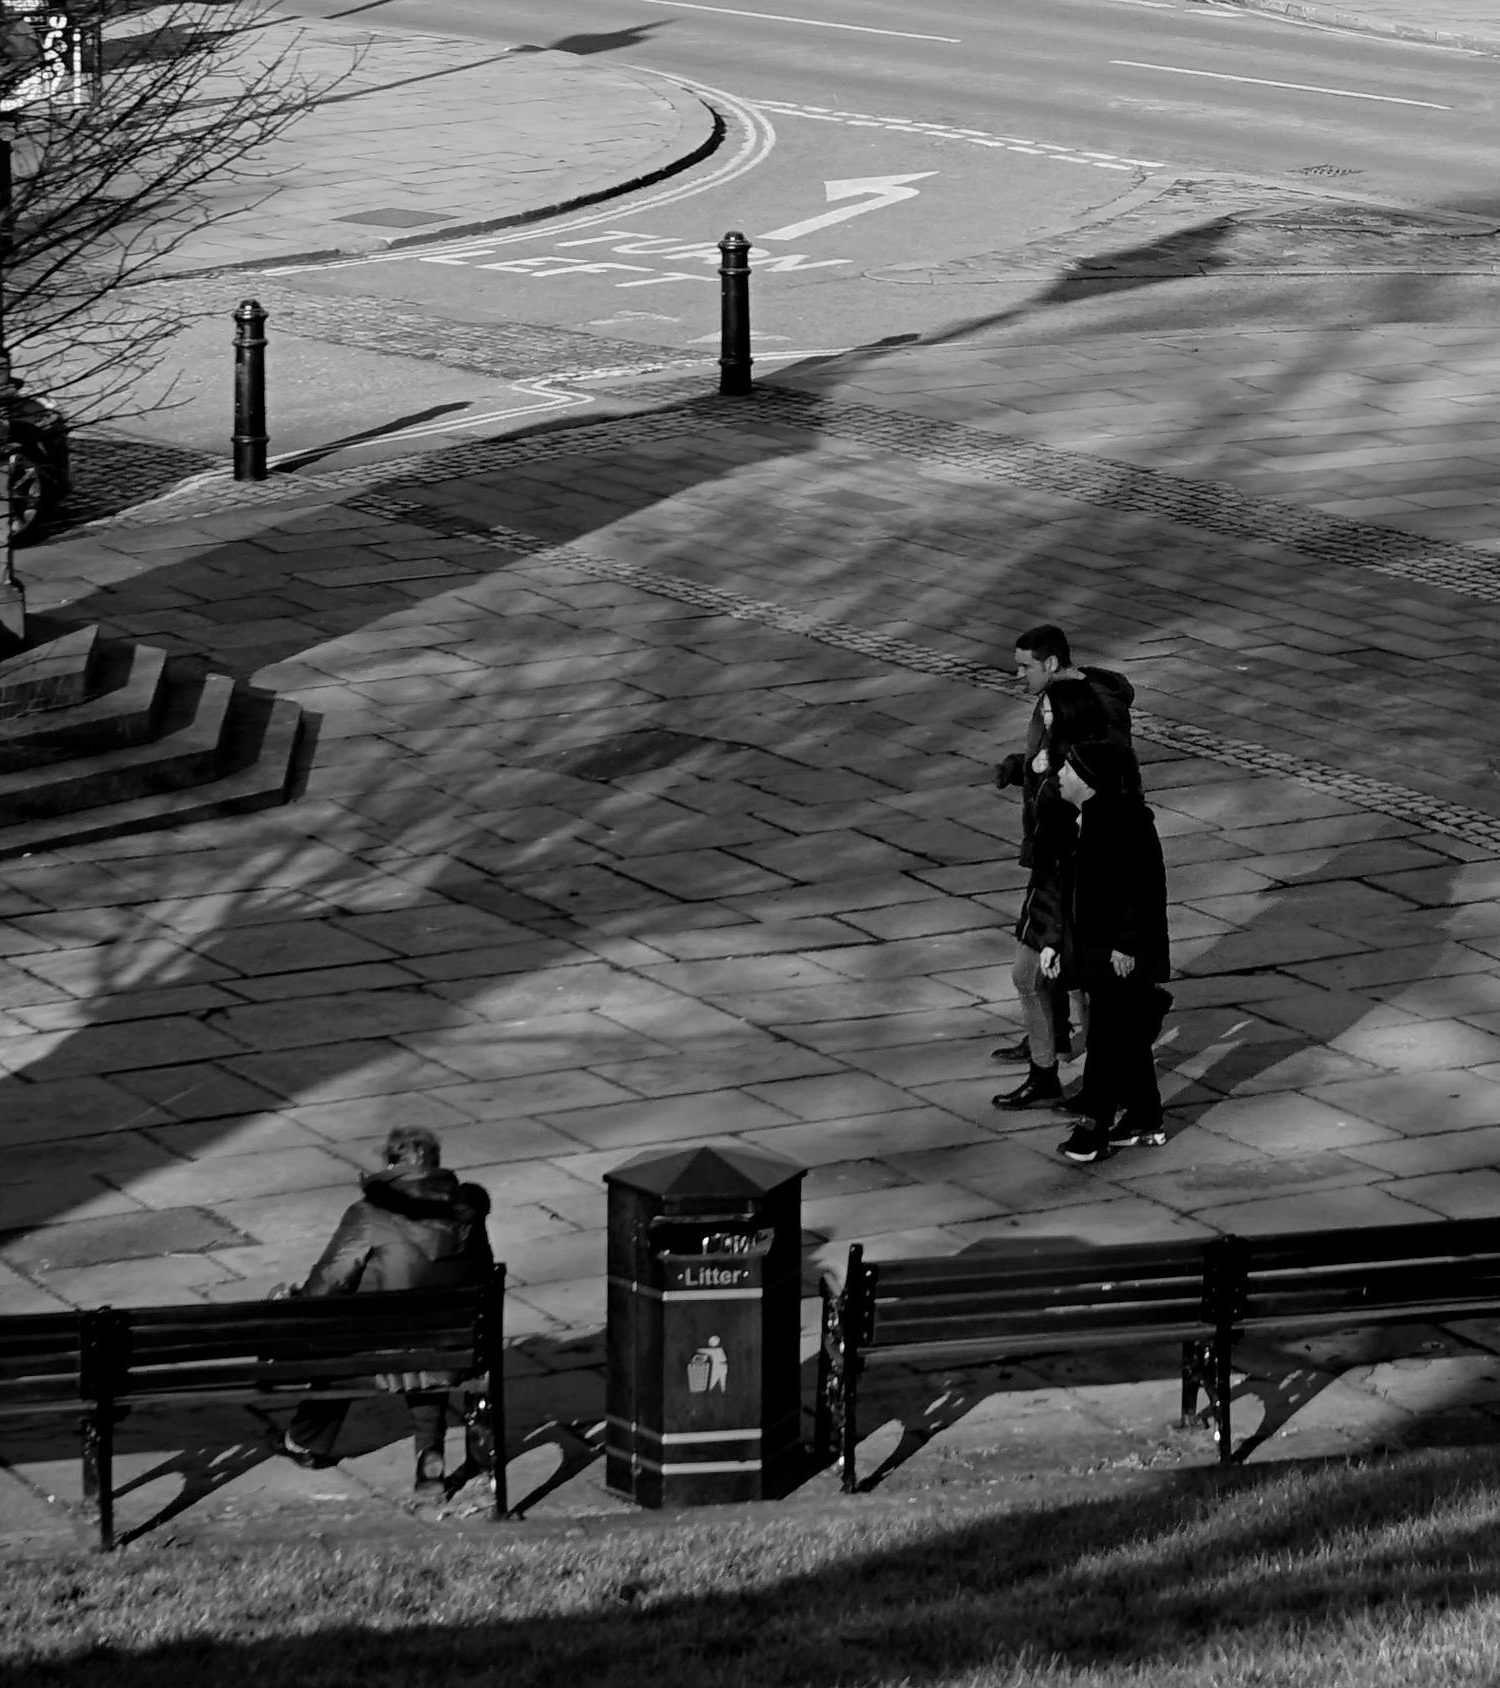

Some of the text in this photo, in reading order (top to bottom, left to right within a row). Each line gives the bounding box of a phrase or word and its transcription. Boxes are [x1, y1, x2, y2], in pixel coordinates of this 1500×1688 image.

[419, 248, 720, 289] LEFT
[558, 229, 852, 274] TURN
[685, 1266, 743, 1287] Litter
